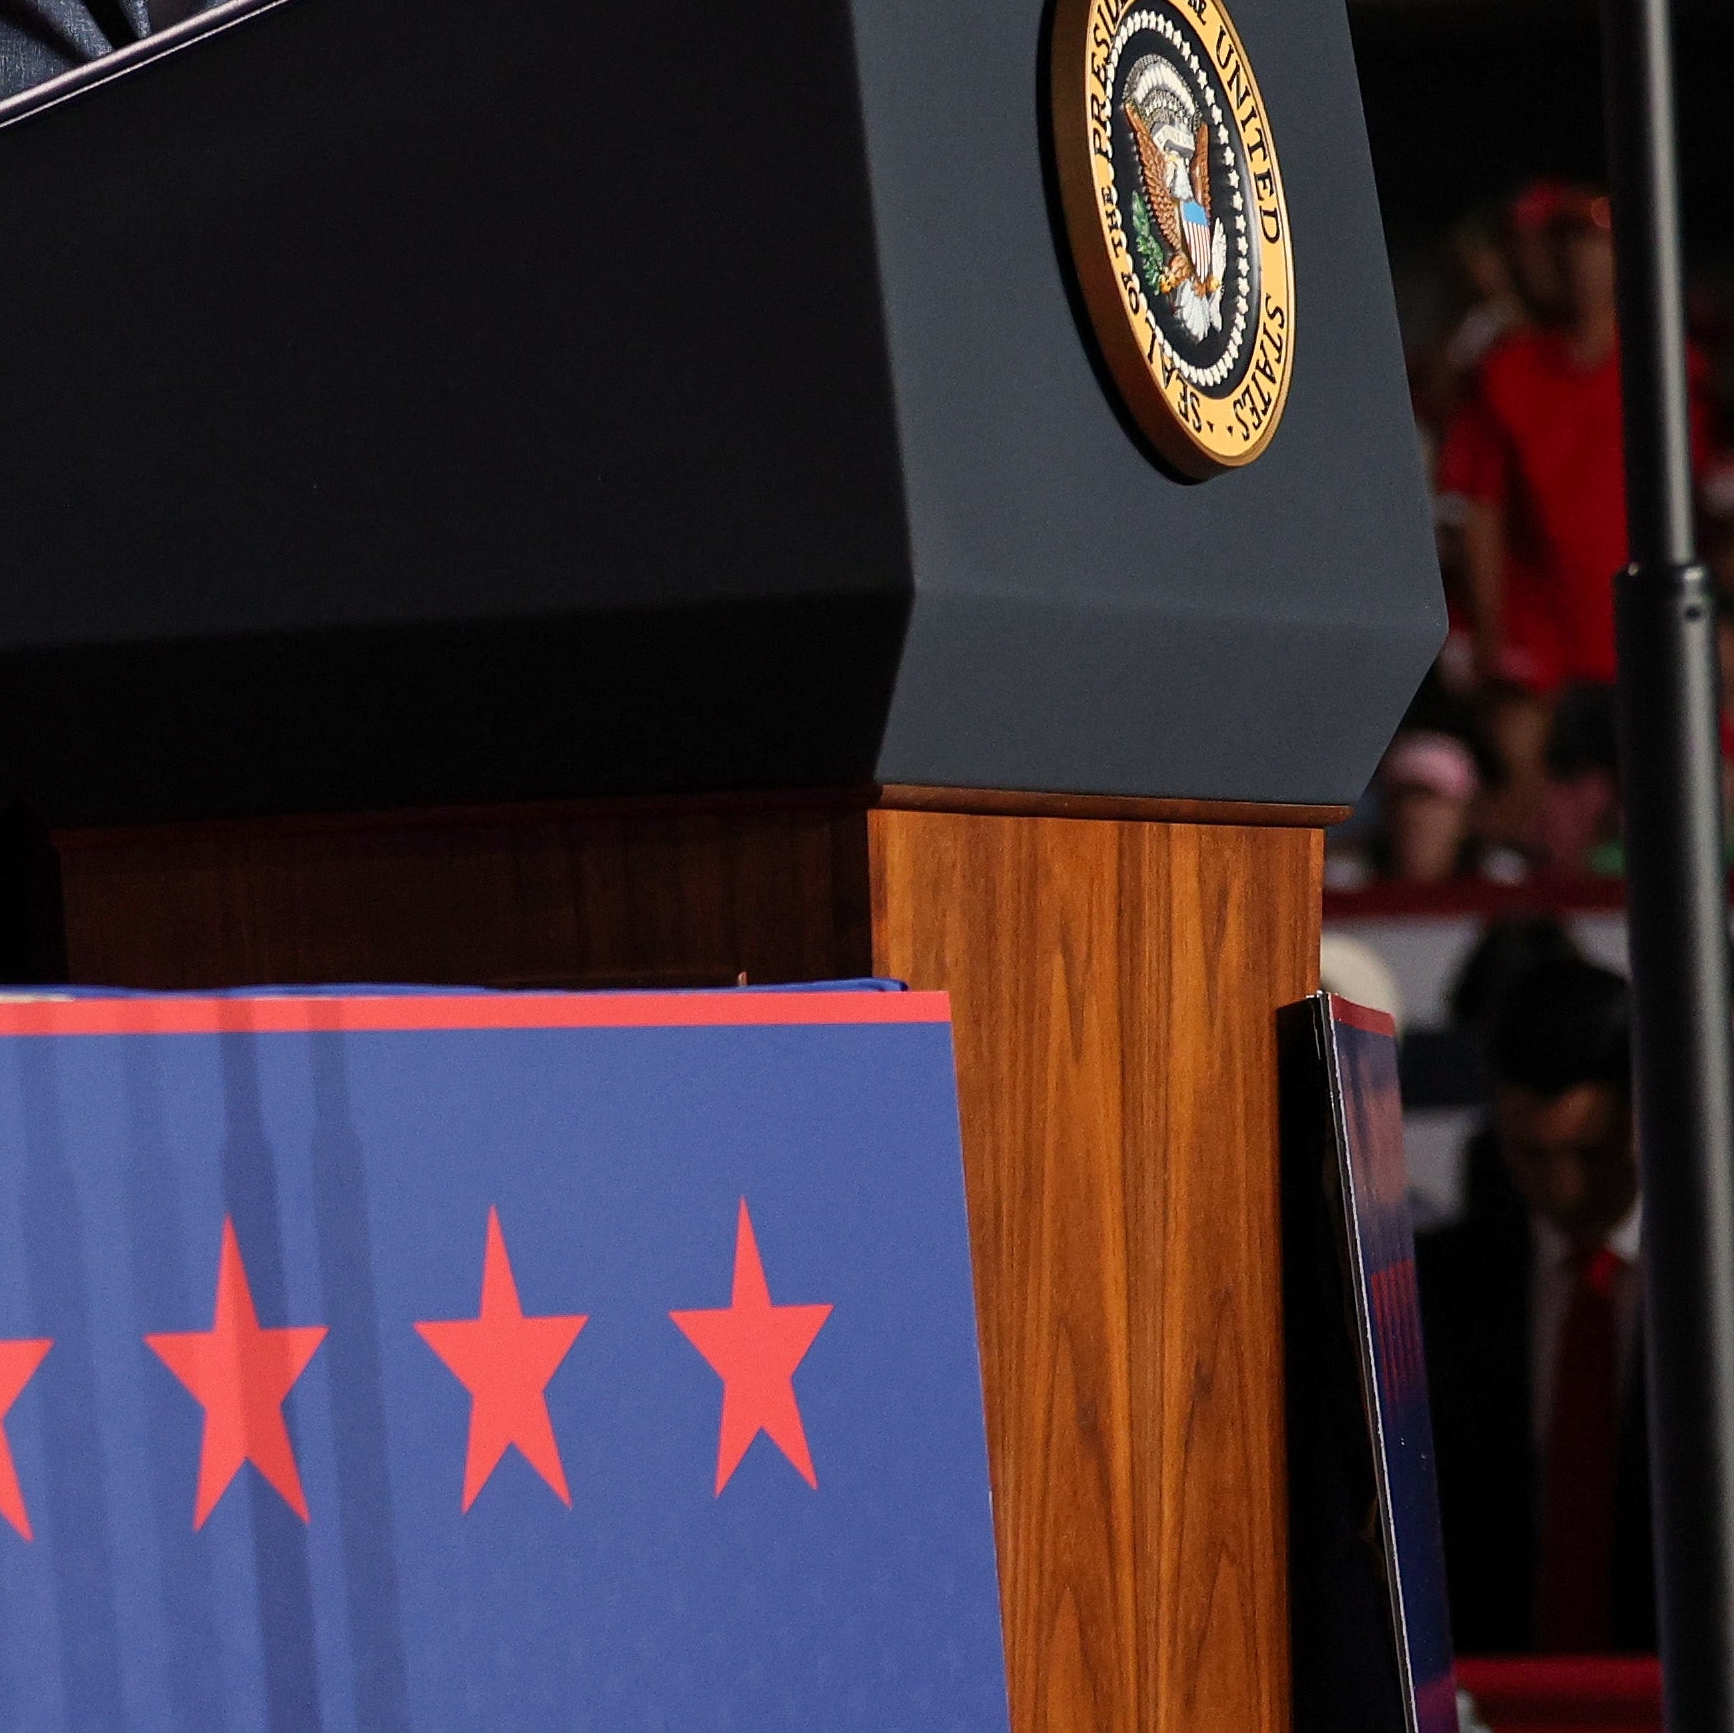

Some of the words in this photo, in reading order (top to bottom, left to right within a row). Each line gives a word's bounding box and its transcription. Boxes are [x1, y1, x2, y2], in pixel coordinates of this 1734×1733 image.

[1215, 25, 1281, 244] UNITED
[1101, 186, 1123, 258] THE
[1121, 271, 1139, 315] OF
[1145, 313, 1203, 434] SEAL
[1233, 293, 1285, 442] STATES
